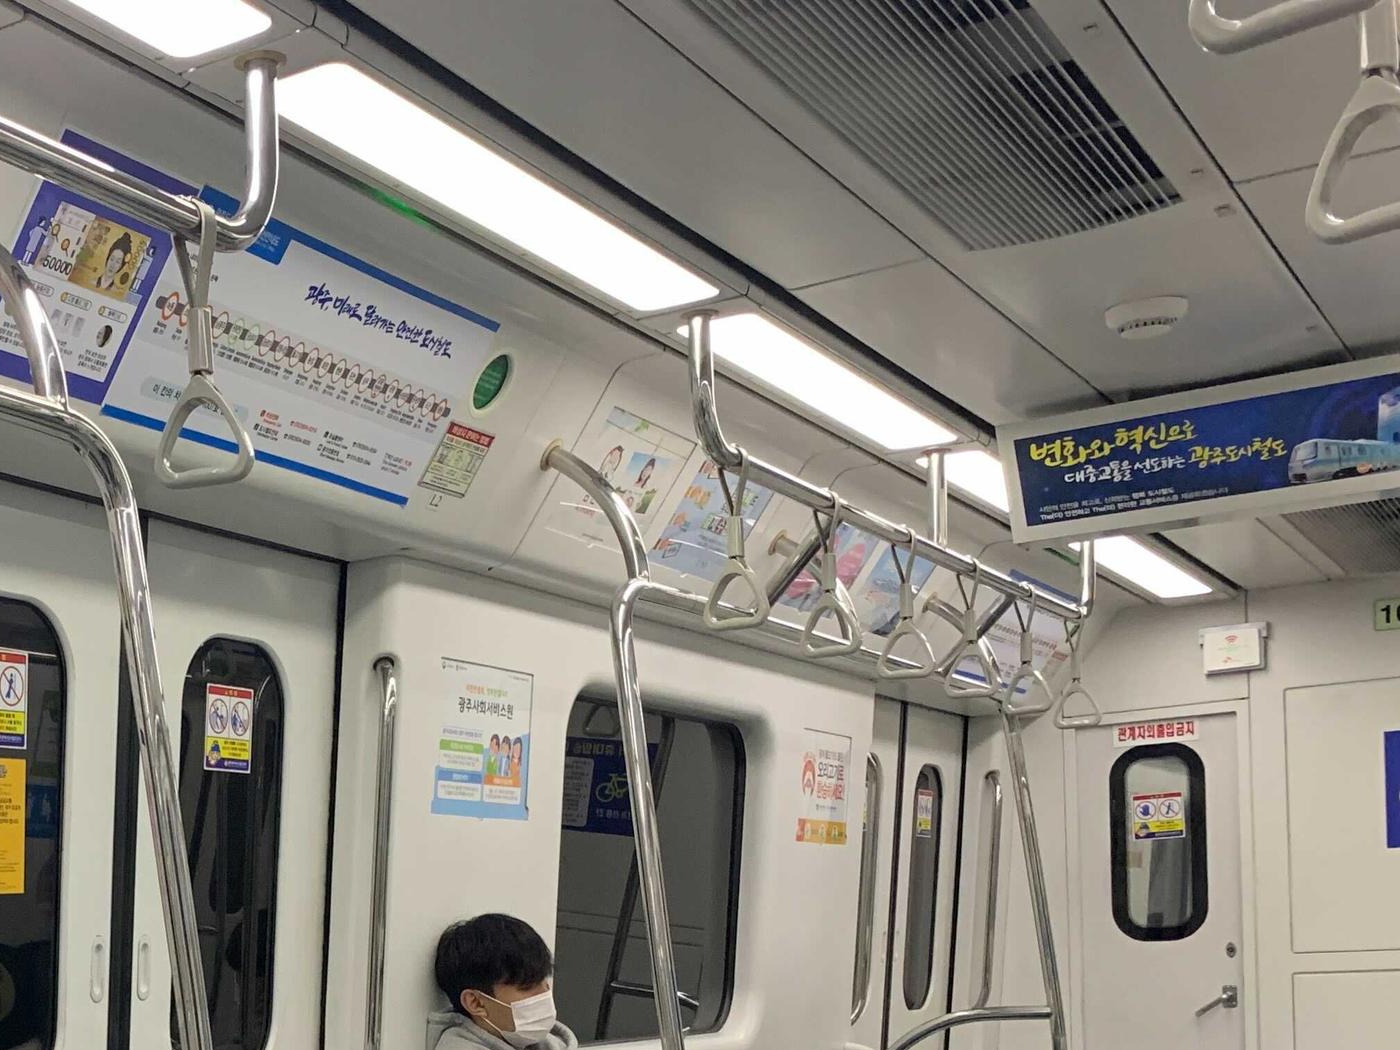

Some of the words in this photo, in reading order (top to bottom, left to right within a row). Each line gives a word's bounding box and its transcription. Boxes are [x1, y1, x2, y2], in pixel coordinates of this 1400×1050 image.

[42, 254, 73, 276] 50000
[333, 296, 363, 322] 미래로
[363, 305, 396, 334] 달려가는
[396, 320, 424, 344] 안전한
[1029, 437, 1115, 469] 변화와
[1113, 419, 1197, 457] 혁신으로
[1064, 459, 1134, 484] 대중교통을
[1134, 454, 1187, 475] 선도하는
[1187, 437, 1289, 469] 광주도시철도
